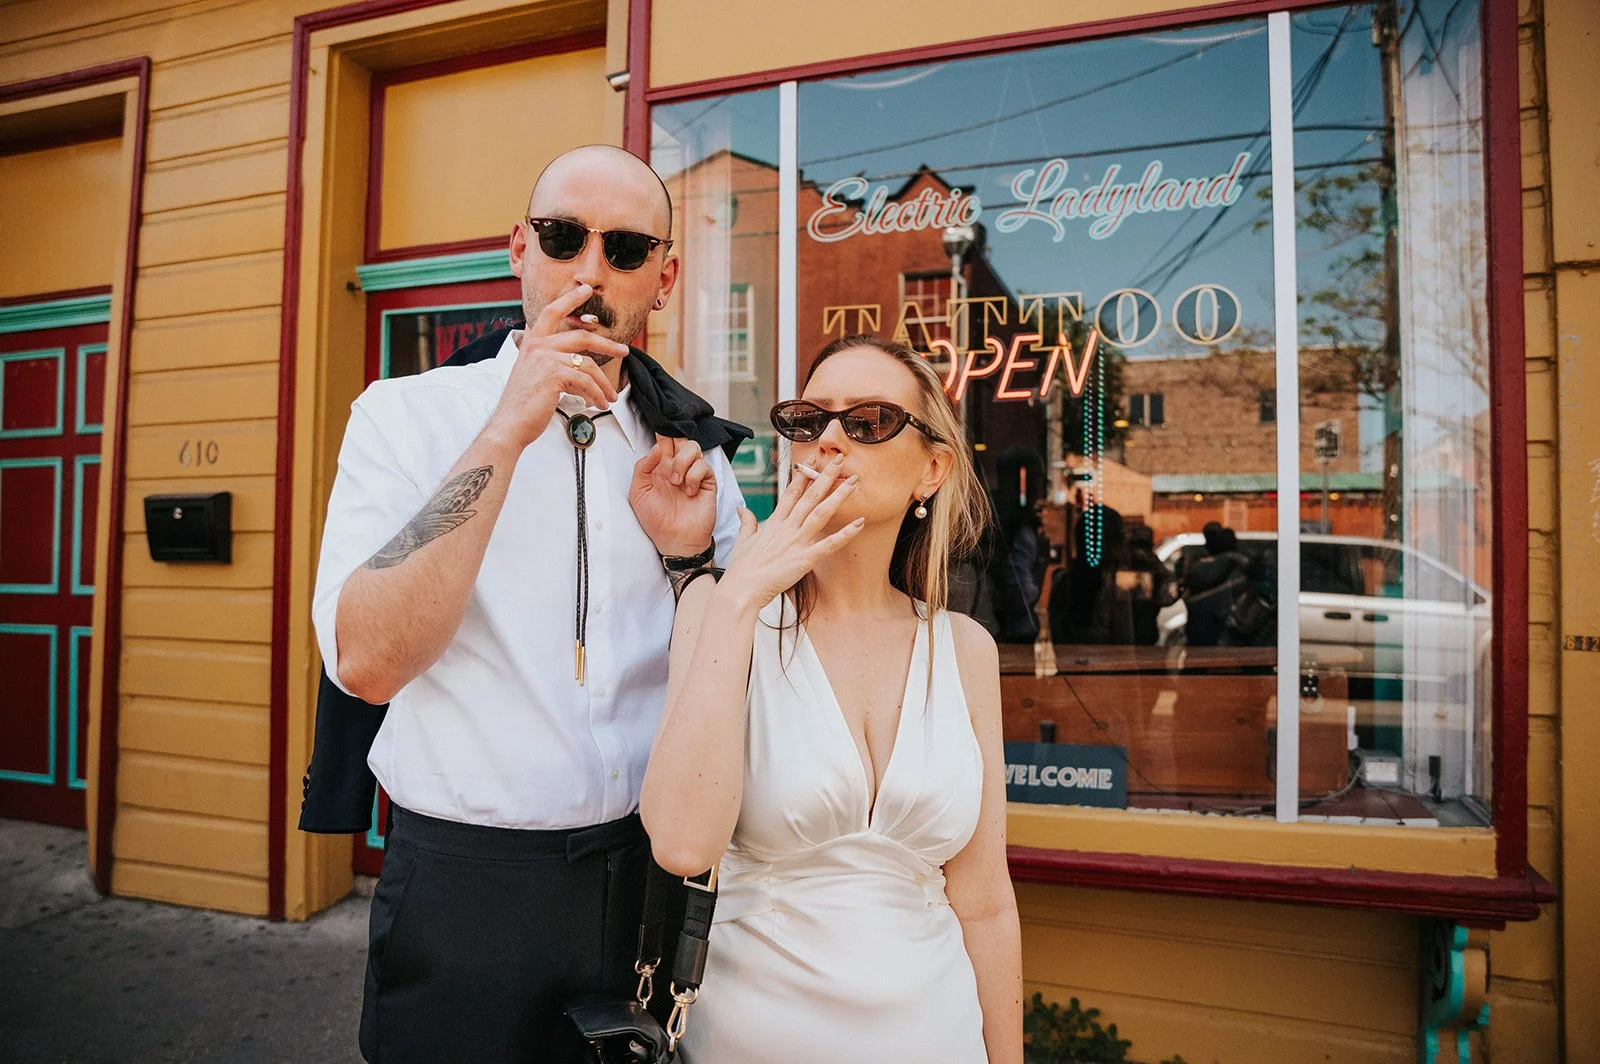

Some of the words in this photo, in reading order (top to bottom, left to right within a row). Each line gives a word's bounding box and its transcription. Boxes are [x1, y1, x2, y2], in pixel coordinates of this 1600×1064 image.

[806, 177, 983, 243] Electric
[995, 151, 1252, 242] Ladyland
[823, 284, 1242, 356] TATTOO
[178, 439, 219, 467] 610
